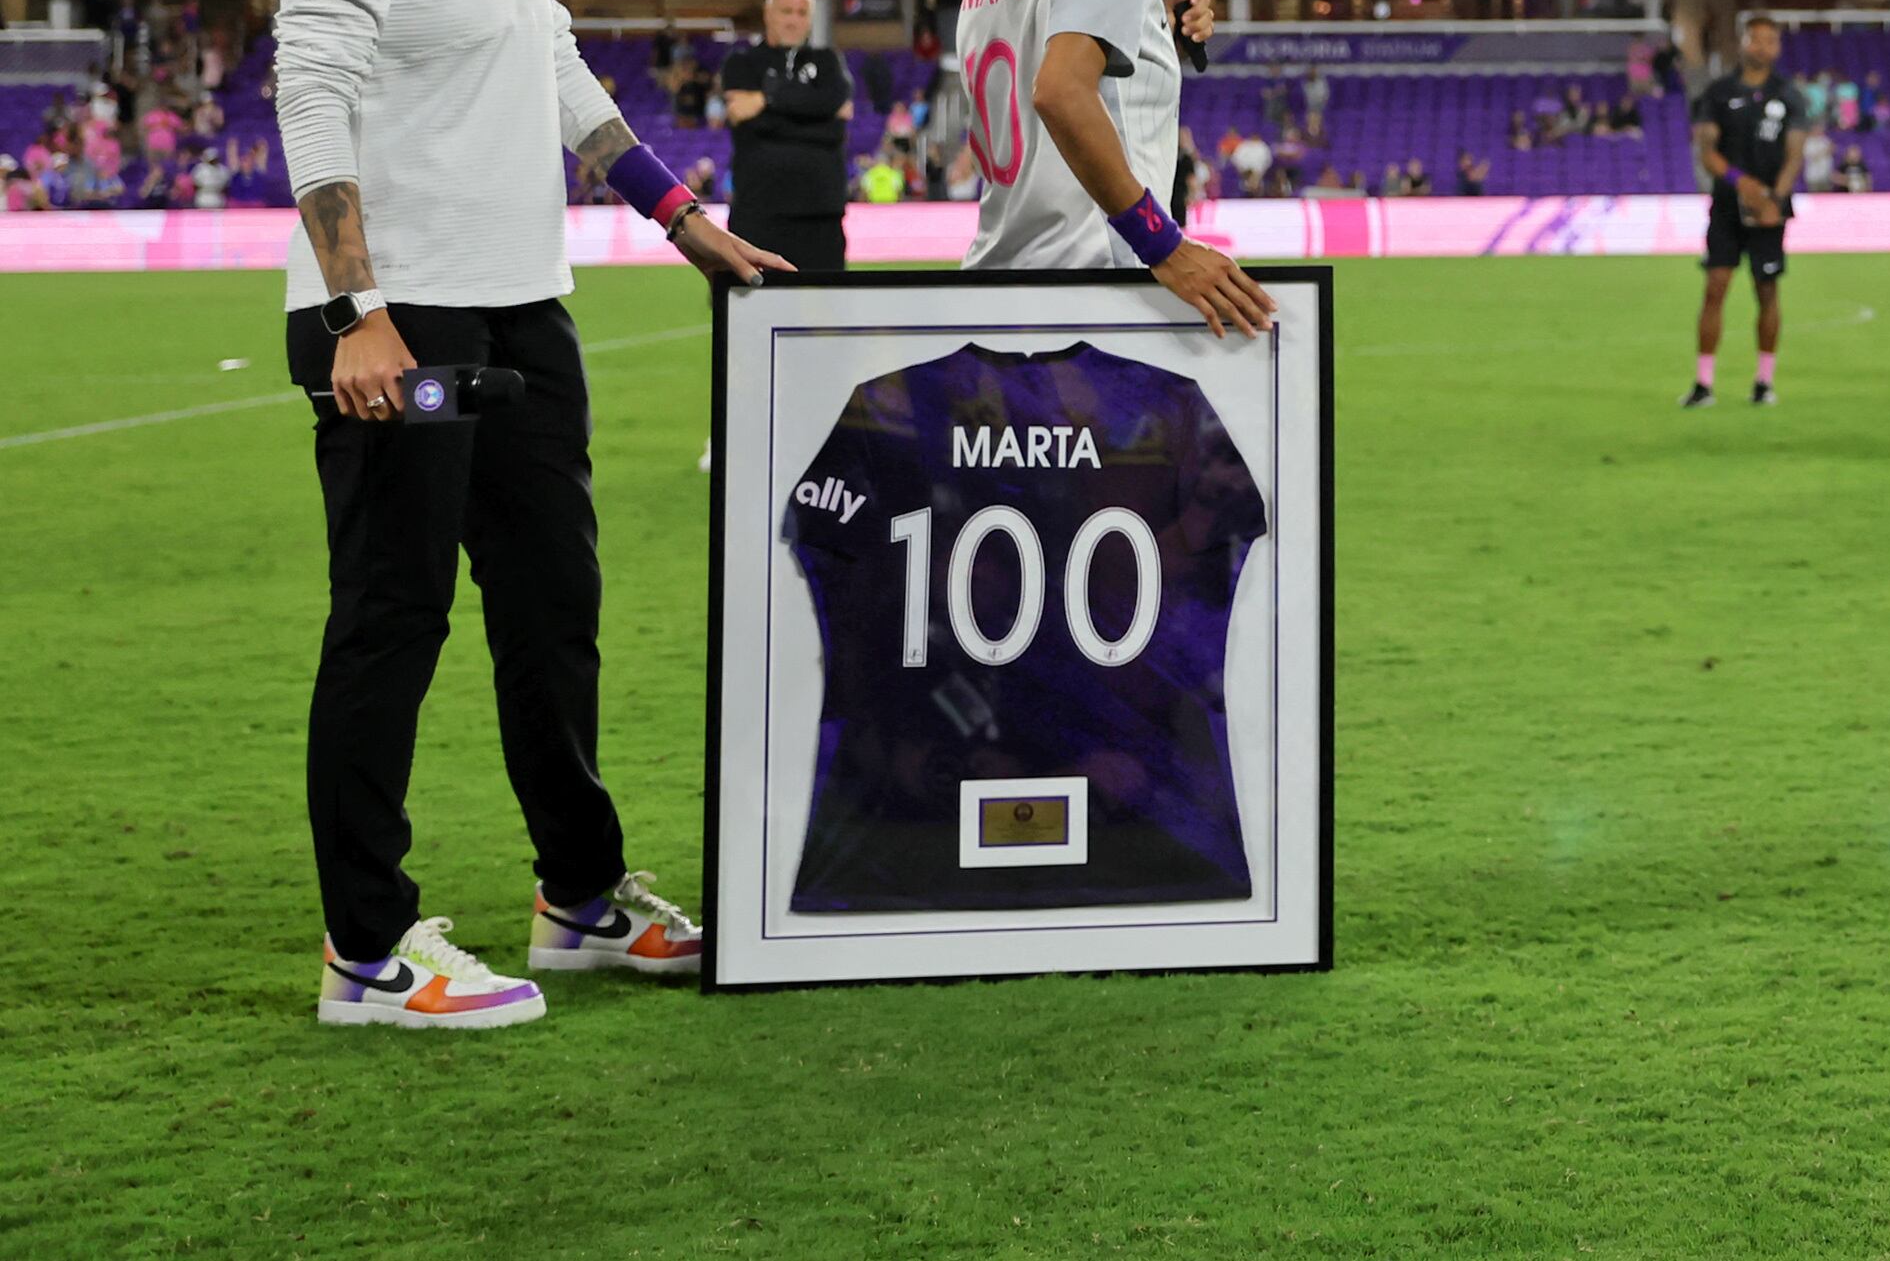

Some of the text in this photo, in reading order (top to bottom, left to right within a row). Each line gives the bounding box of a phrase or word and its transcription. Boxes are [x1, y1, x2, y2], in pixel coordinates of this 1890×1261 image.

[952, 425, 1102, 469] MARTA
[795, 477, 867, 524] ally
[891, 504, 1163, 668] 100
